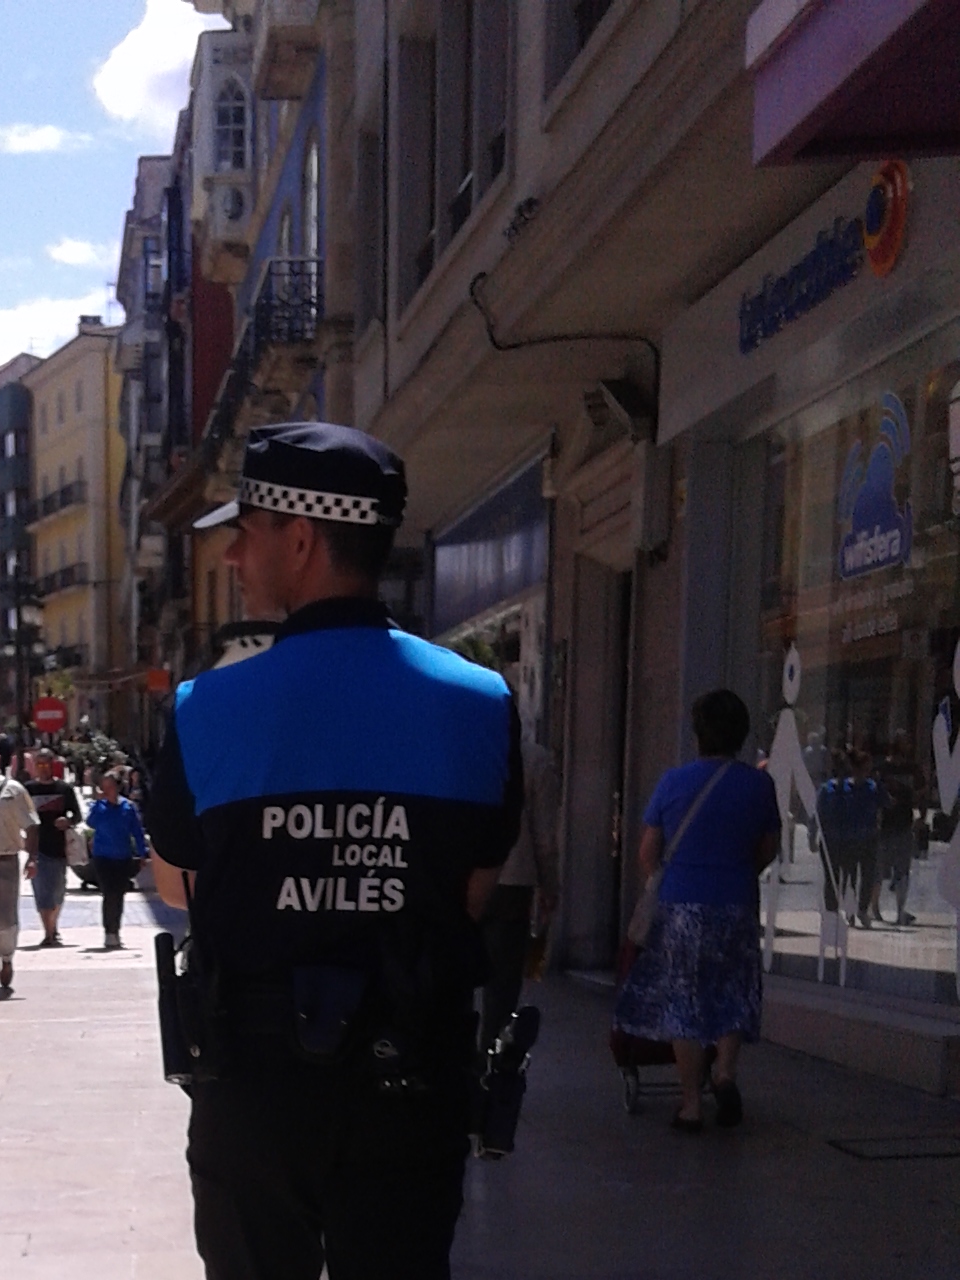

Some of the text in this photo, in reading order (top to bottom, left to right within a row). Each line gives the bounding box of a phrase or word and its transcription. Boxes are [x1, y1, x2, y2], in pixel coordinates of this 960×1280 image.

[262, 797, 410, 841] POLICÍA
[332, 844, 408, 868] LOCAL
[276, 869, 405, 913] AVILÉS
